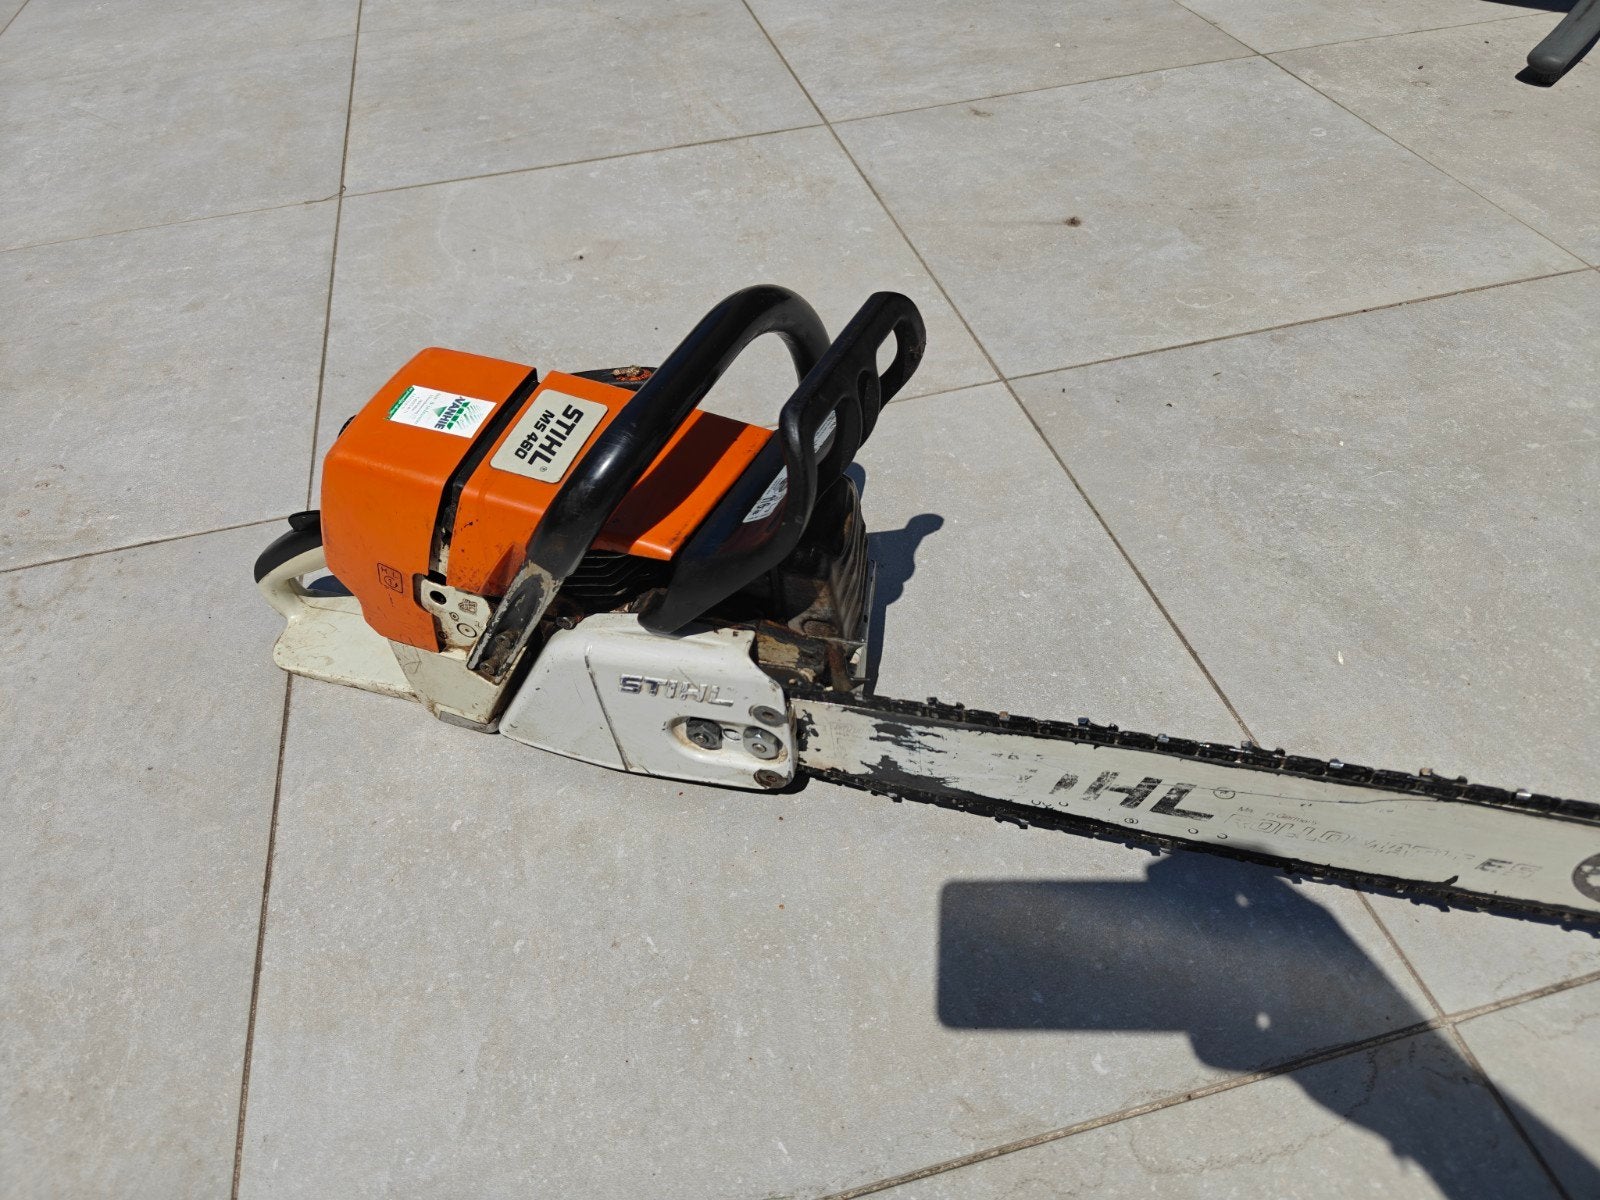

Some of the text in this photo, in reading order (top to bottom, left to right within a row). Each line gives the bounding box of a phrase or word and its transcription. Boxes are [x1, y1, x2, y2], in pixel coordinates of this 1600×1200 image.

[514, 409, 555, 460] MS 460
[528, 404, 584, 465] STIHL
[620, 673, 734, 707] STIHL
